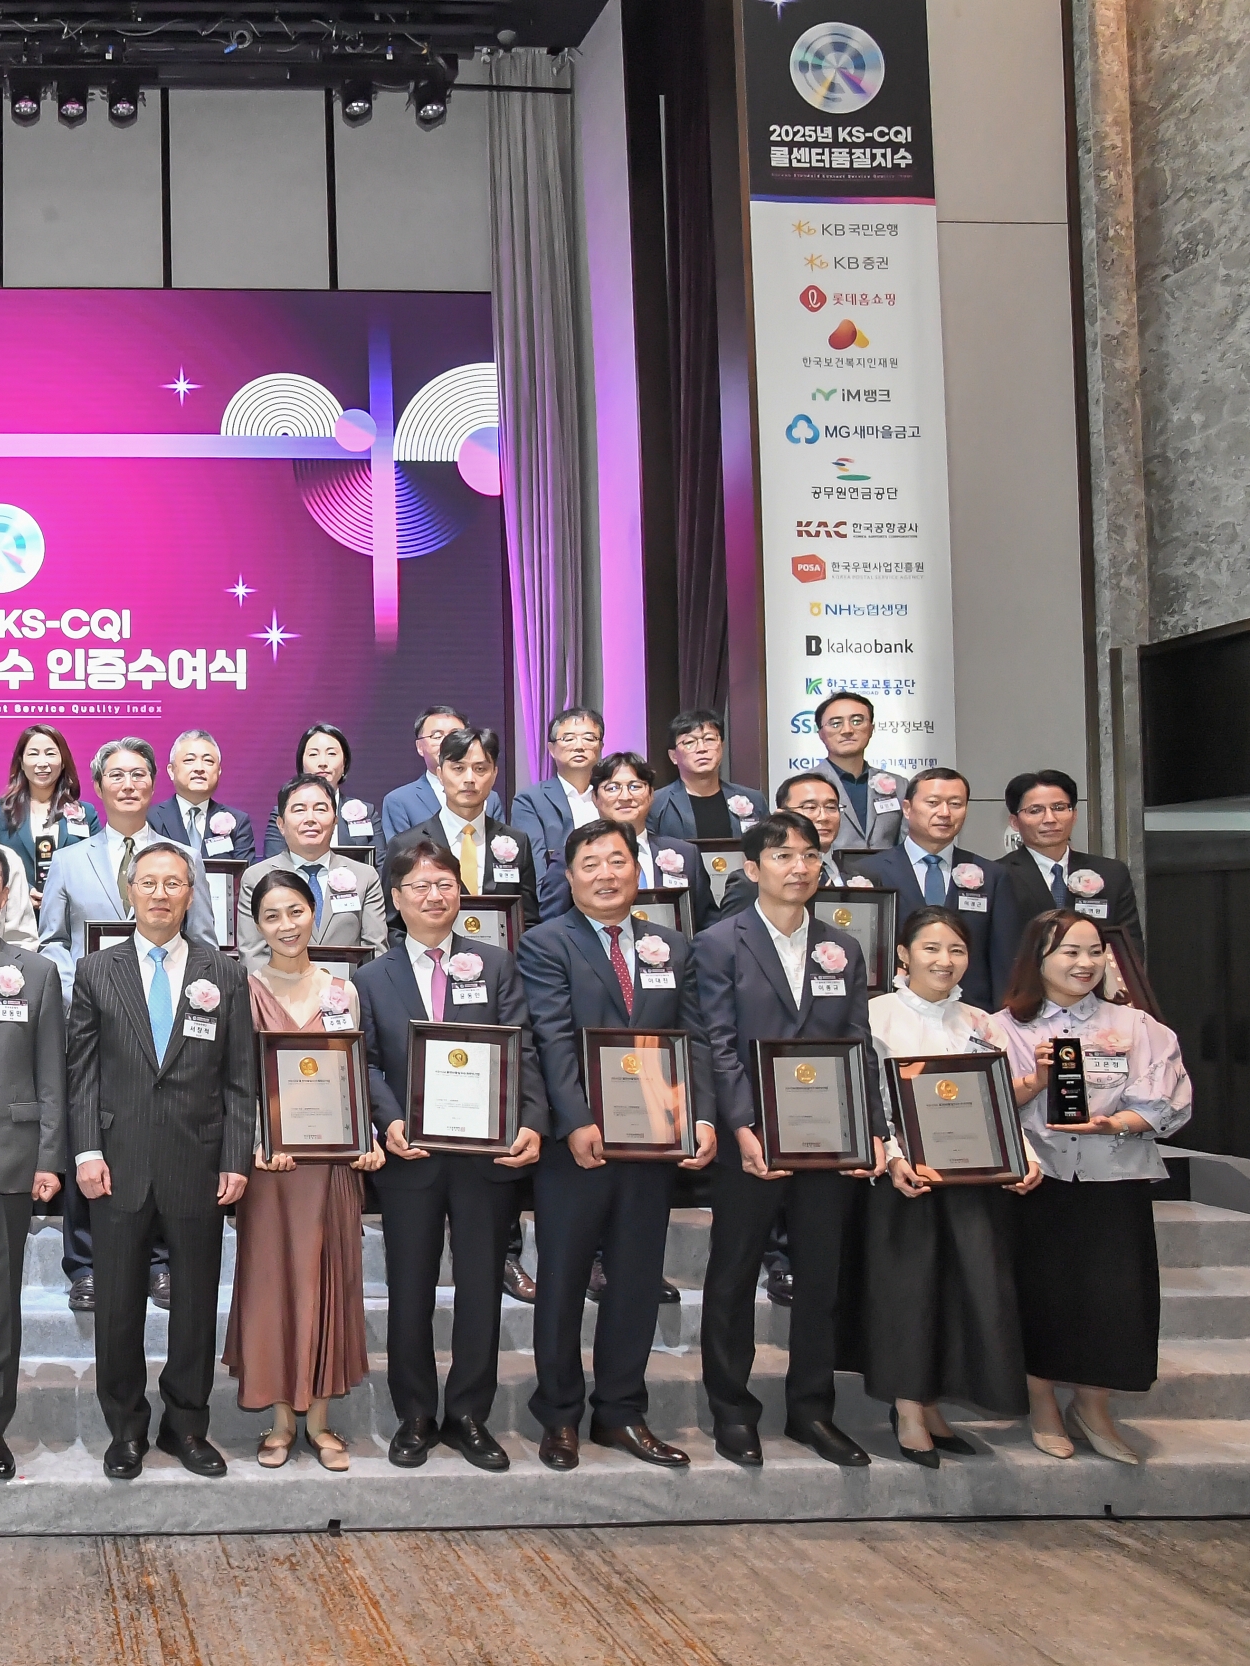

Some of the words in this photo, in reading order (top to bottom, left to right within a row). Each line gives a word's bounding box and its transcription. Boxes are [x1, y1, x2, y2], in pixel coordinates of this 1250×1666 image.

[769, 124, 833, 142] 2025년
[838, 126, 912, 144] KS-CQI
[770, 146, 913, 168] 콜센터품질지수
[832, 293, 896, 306] 롯데홈쇼핑
[802, 357, 898, 368] 한국보건복지인재원
[811, 486, 898, 500] 공무원연금공단
[796, 520, 848, 538] KAC
[852, 522, 918, 534] 한국공항공사
[798, 564, 820, 572] POSA
[832, 562, 924, 572] 한국우편사업진흥원
[827, 638, 914, 654] kakaobank
[46, 648, 248, 691] 인증수여식
[827, 678, 916, 696] 한국도로교통공단
[14, 704, 66, 714] Service
[71, 704, 121, 714] Quality
[126, 704, 162, 714] Index
[874, 720, 935, 734] 보장정보원
